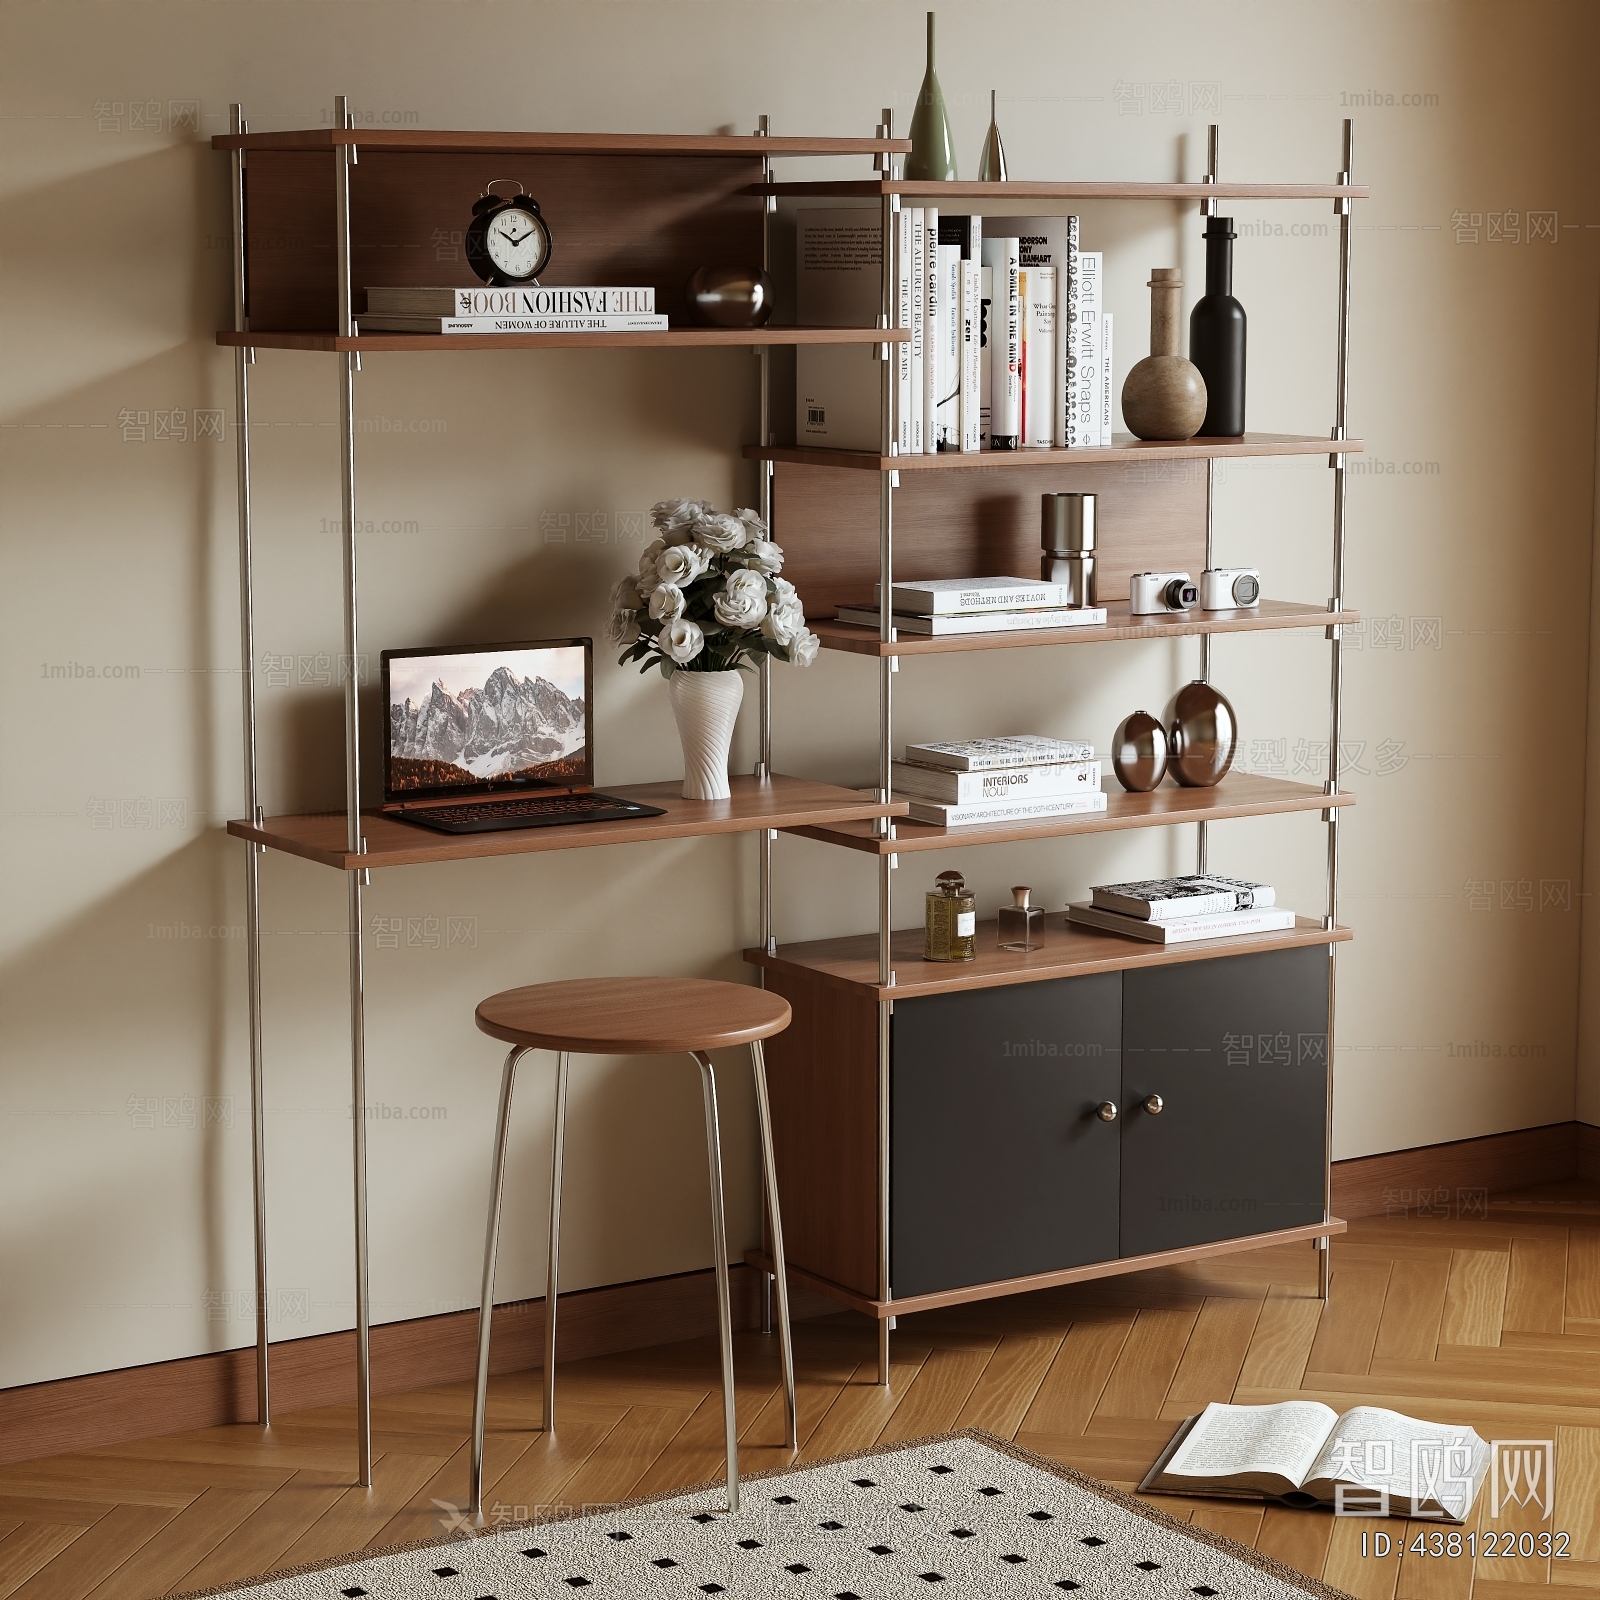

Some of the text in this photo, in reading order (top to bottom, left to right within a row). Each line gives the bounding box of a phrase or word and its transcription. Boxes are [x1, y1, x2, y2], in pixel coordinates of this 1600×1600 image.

[1010, 257, 1017, 265] A
[927, 228, 938, 317] pierre cardin
[460, 291, 652, 314] THE FASHION BOOK
[914, 294, 922, 309] OF
[1009, 305, 1016, 316] IN
[494, 320, 607, 330] THE ALLURE OF WOMEN
[1078, 258, 1096, 424] Elliott Erwitt Snaps
[902, 342, 908, 356] OF
[960, 594, 1046, 606] MOVIES AND METHODS
[982, 774, 1029, 787] INTERIORS
[1078, 773, 1088, 782] 2
[951, 812, 976, 821] VISIONARY
[976, 808, 1014, 818] ARCHITECTURE
[1022, 806, 1033, 814] THE
